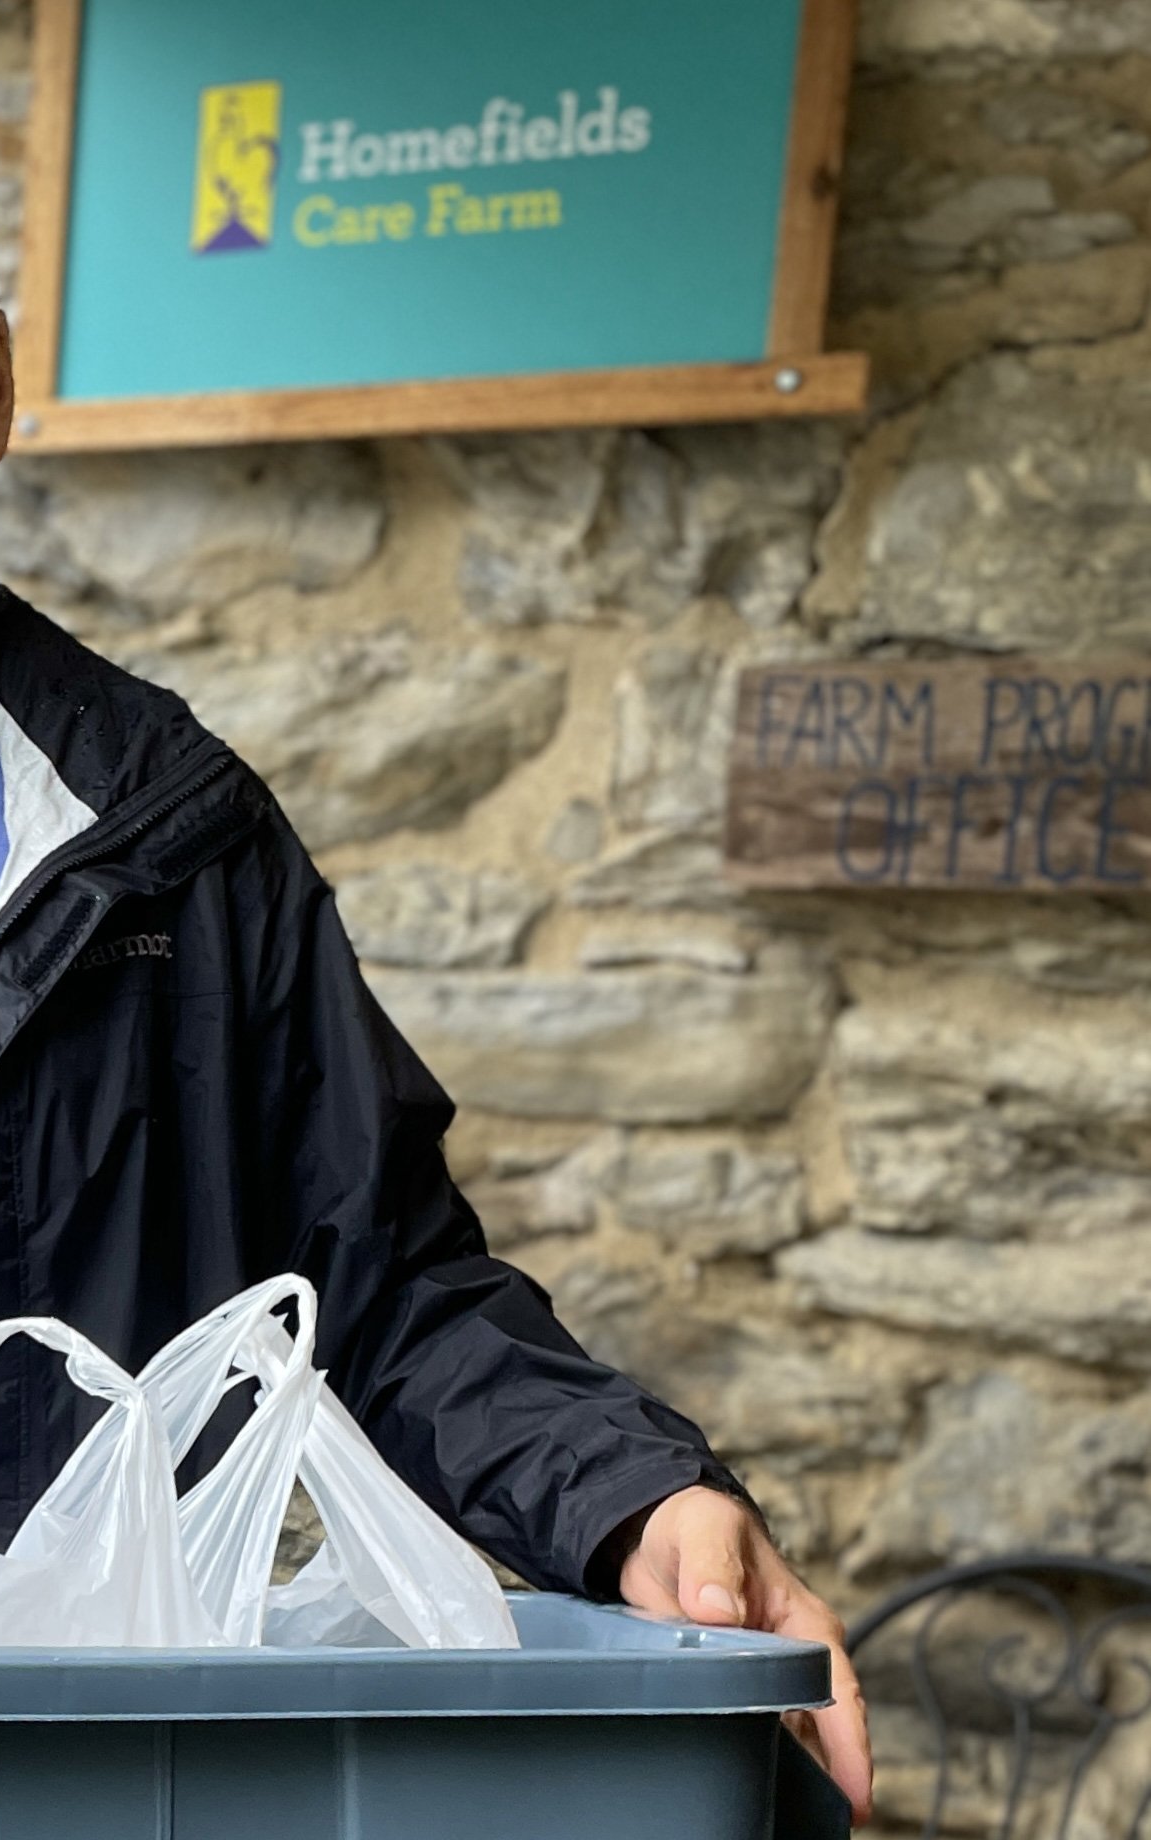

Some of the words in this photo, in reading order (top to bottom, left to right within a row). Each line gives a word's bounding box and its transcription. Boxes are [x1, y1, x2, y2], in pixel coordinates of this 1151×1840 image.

[297, 86, 652, 182] Homefields
[292, 194, 416, 247] Care
[425, 182, 563, 236] Farm
[757, 674, 937, 770] FARM
[979, 675, 1151, 780] PROG
[836, 774, 1149, 886] OFFICE
